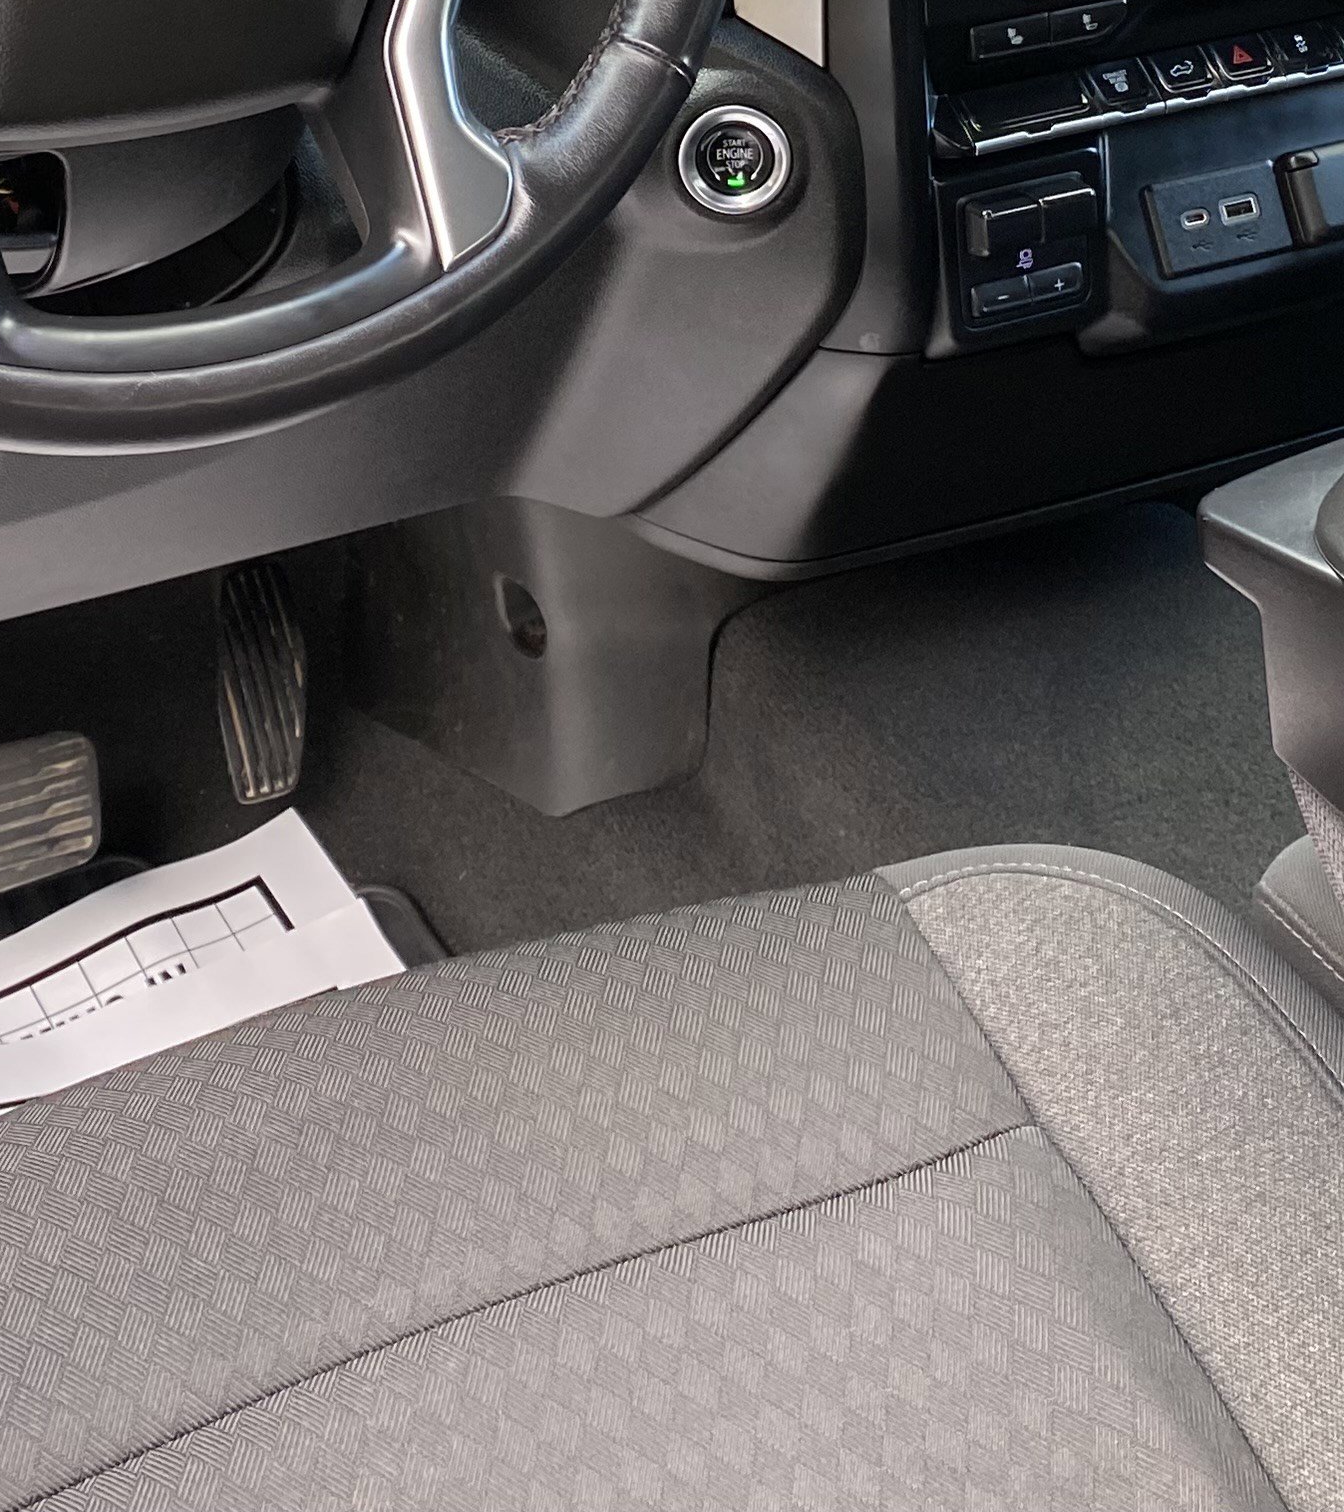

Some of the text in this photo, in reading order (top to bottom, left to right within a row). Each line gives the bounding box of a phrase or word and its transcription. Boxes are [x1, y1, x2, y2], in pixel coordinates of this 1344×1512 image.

[722, 139, 746, 147] START
[716, 148, 754, 160] ENGINE
[725, 160, 745, 169] STOP
